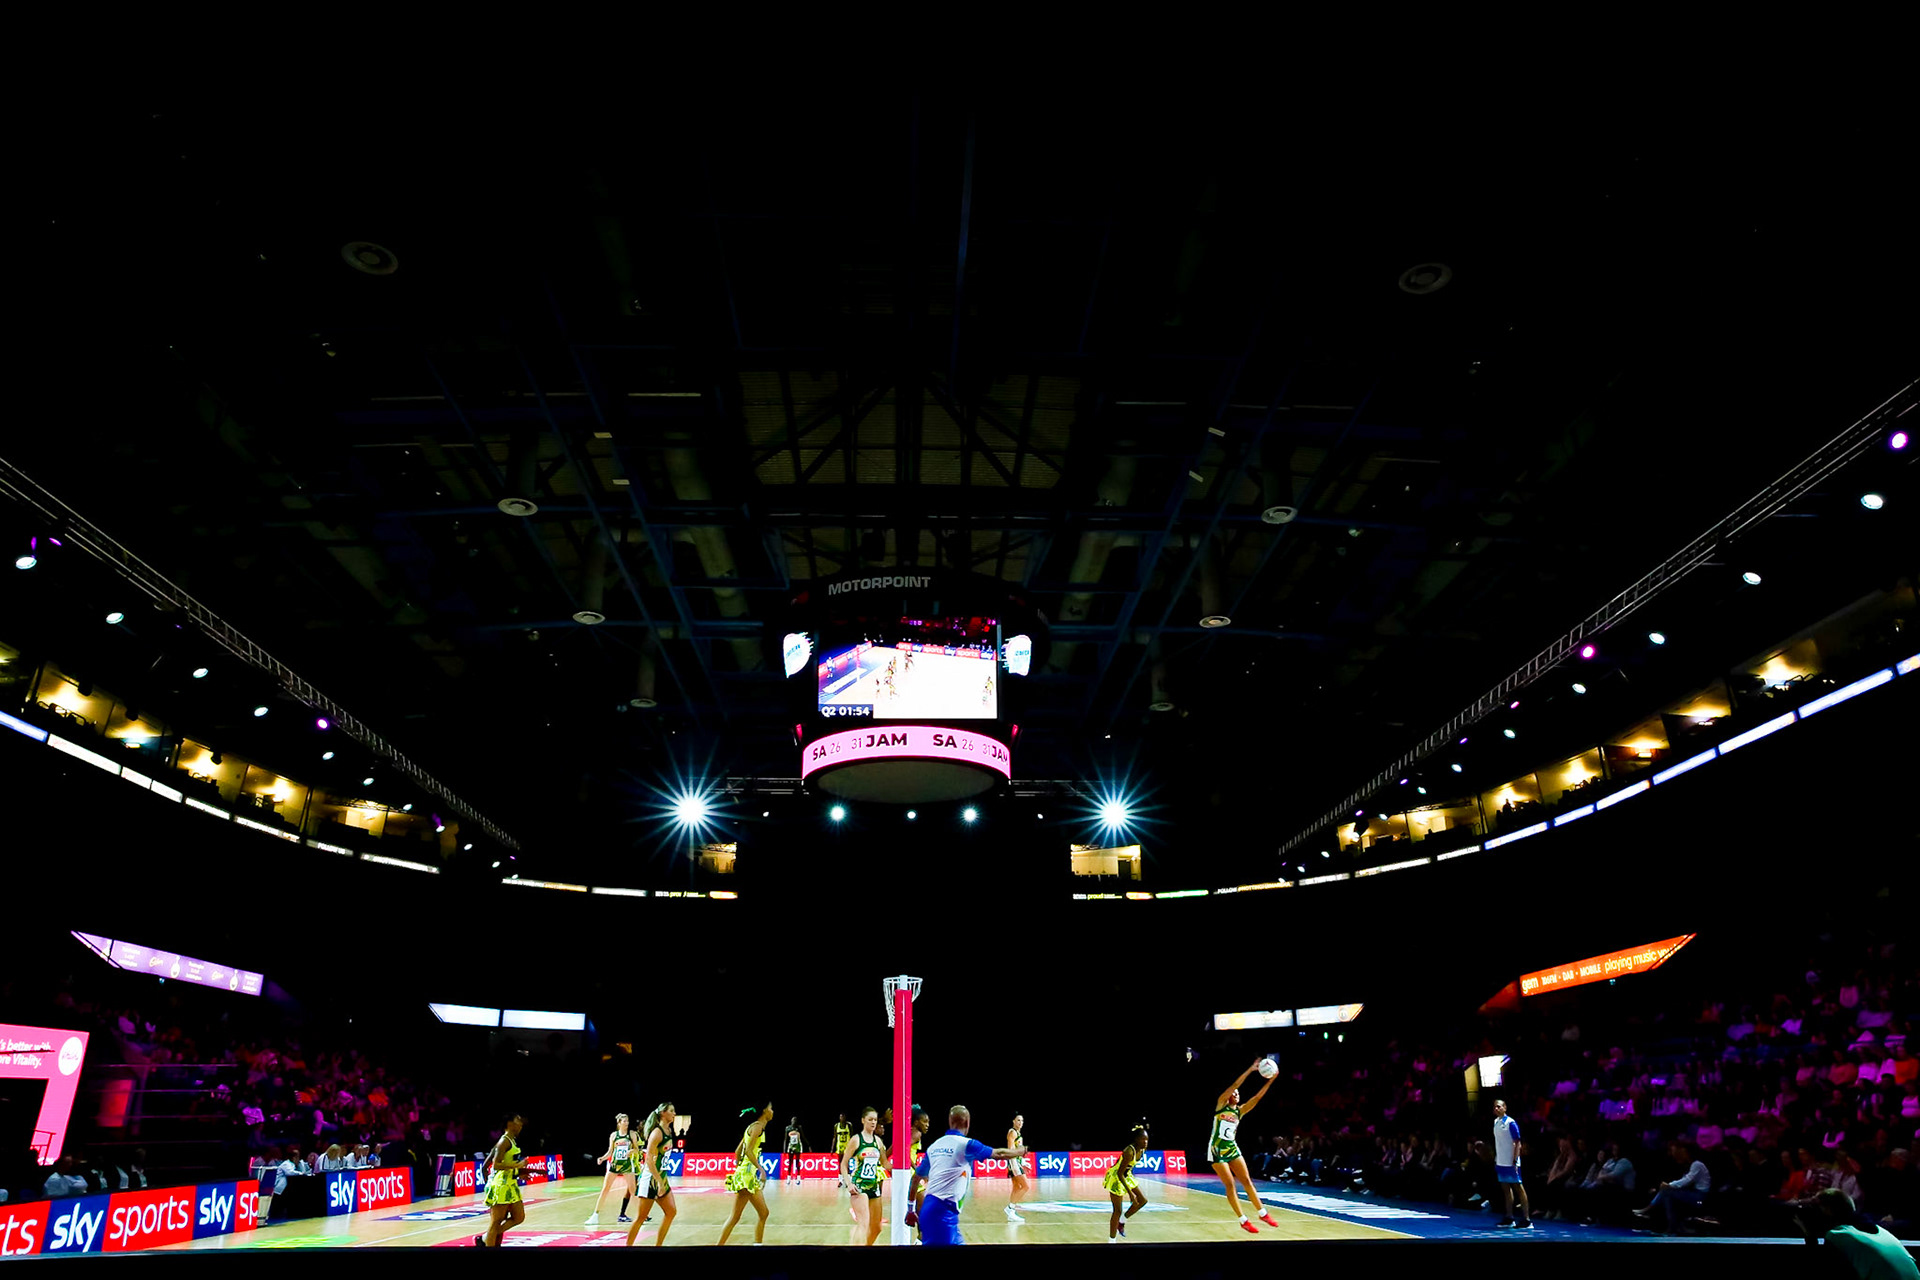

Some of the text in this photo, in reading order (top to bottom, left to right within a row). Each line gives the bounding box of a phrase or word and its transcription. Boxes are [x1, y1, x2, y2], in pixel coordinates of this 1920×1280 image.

[828, 576, 931, 596] MOTORPOINT
[821, 706, 870, 718] Q2 01:54
[812, 744, 827, 761] SA
[830, 741, 841, 755] 26
[851, 737, 862, 750] 31
[865, 733, 908, 748] JAM
[932, 734, 957, 748] SA
[962, 739, 974, 751] 26
[982, 743, 991, 755] 31
[1521, 977, 1539, 994] gem
[1563, 971, 1574, 981] DAB
[1579, 963, 1601, 976] MOBILE
[1604, 956, 1633, 974] playing
[1633, 949, 1657, 965] music
[7, 1039, 33, 1051] better
[455, 1166, 473, 1188] orts
[476, 1163, 486, 1186] sk
[547, 1157, 556, 1179] sky
[862, 1162, 877, 1176] GS
[1039, 1154, 1067, 1173] sky
[1073, 1155, 1118, 1172] sport
[1135, 1154, 1162, 1171] sky
[1168, 1156, 1187, 1171] sp
[329, 1171, 405, 1212] sky sports
[50, 1202, 104, 1253] sky
[110, 1195, 189, 1247] sports
[199, 1187, 234, 1231] sky
[239, 1191, 259, 1226] sp
